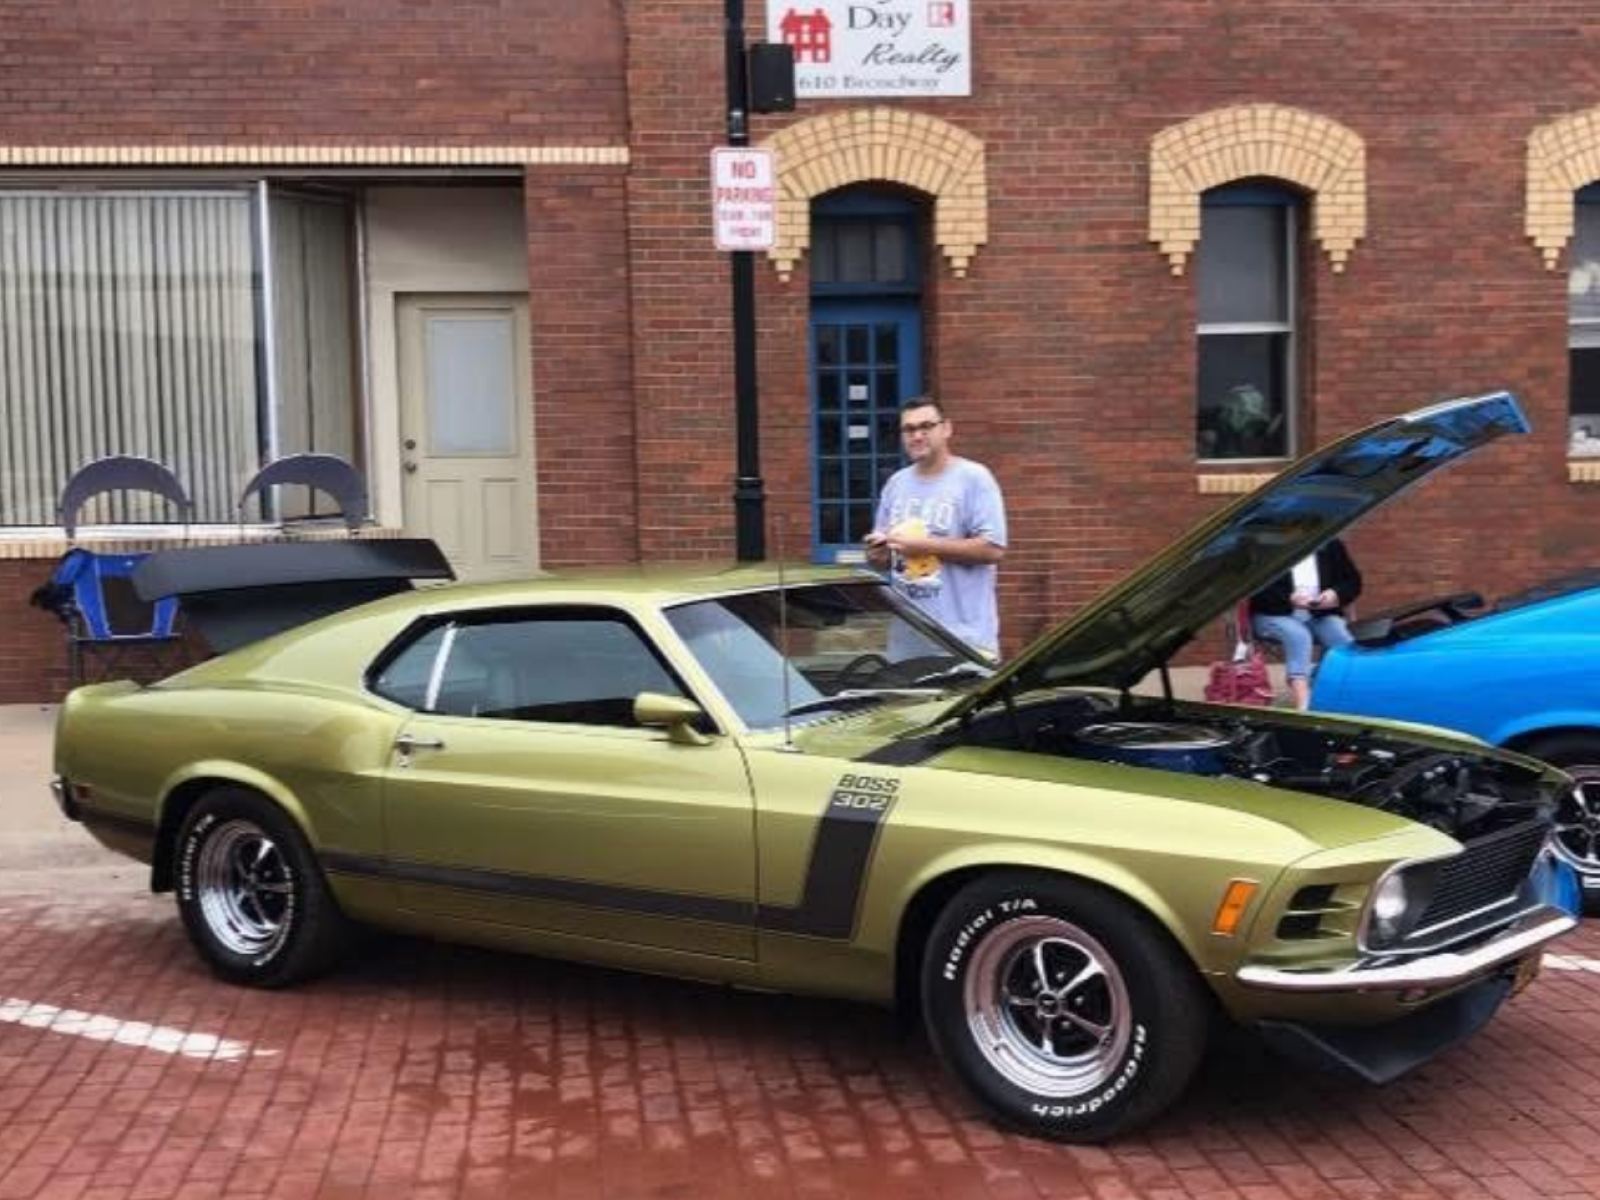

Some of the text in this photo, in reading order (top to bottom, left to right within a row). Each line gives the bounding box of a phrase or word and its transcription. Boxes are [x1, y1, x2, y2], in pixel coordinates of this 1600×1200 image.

[848, 6, 912, 37] Day
[862, 43, 960, 73] Realty
[843, 75, 940, 90] Broadway
[731, 160, 755, 179] NO
[717, 187, 772, 203] PARKING
[838, 773, 900, 793] BOSS
[833, 791, 891, 811] 302
[943, 898, 1038, 980] Radial T/A
